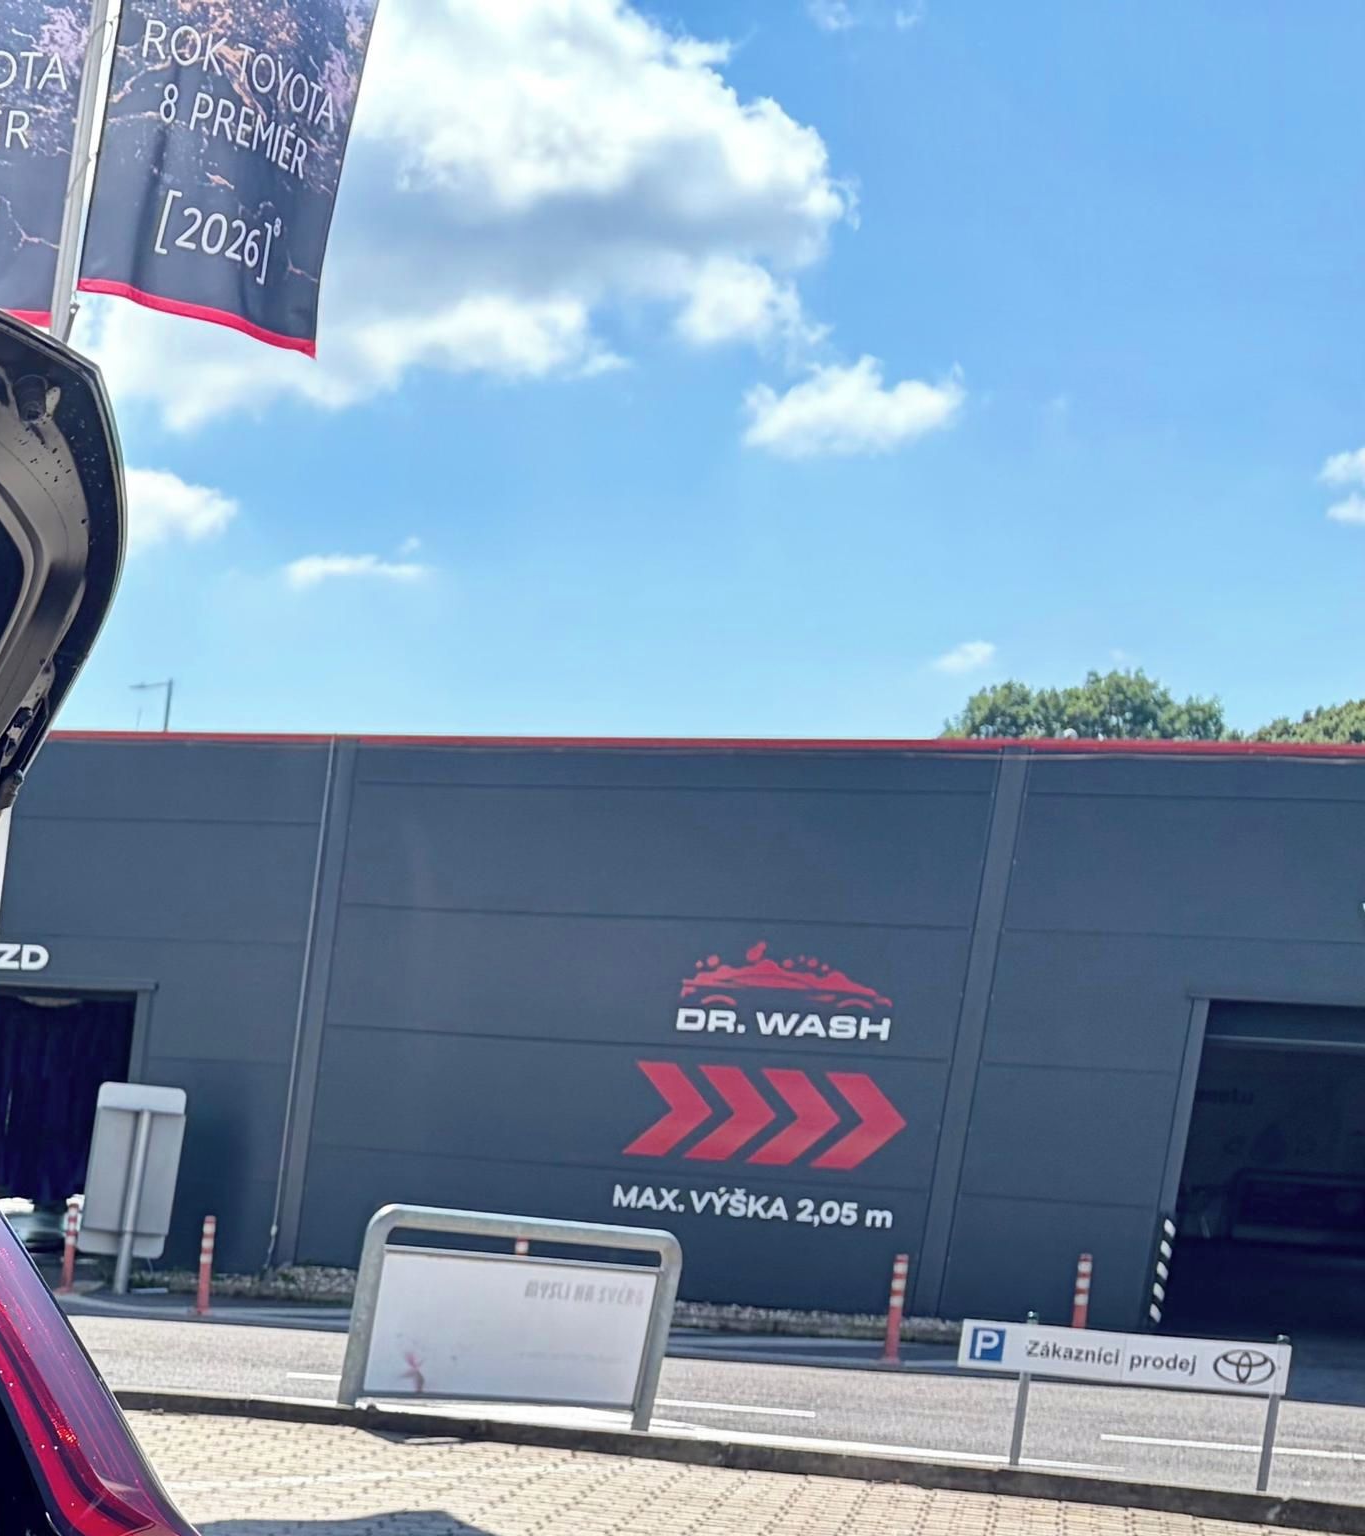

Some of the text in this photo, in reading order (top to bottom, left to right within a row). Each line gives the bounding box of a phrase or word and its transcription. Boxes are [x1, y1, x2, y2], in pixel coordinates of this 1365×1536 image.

[142, 19, 335, 132] ROK TOYOTA
[160, 83, 308, 180] 8 PREMIÉR
[676, 1008, 892, 1041] DR. WASH
[612, 1184, 894, 1229] MAX. VÝŠKA 2,05 m
[975, 1329, 1000, 1360] P
[1129, 1354, 1197, 1377] prodej
